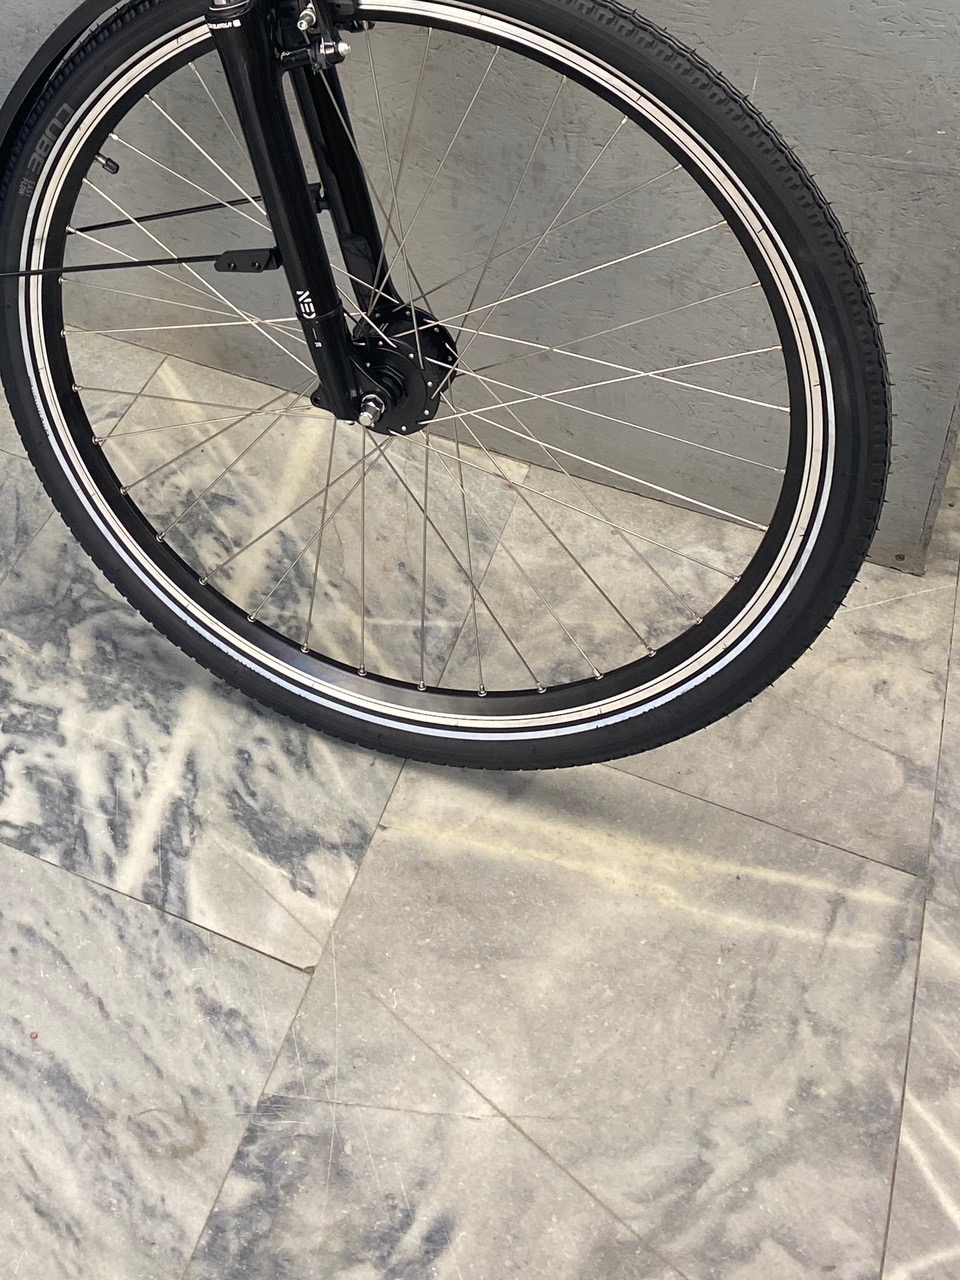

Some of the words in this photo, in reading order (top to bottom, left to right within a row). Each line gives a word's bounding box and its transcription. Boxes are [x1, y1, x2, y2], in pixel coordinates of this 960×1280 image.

[27, 103, 75, 175] CUBE
[18, 177, 28, 196] FLOW
[24, 180, 36, 198] EAST
